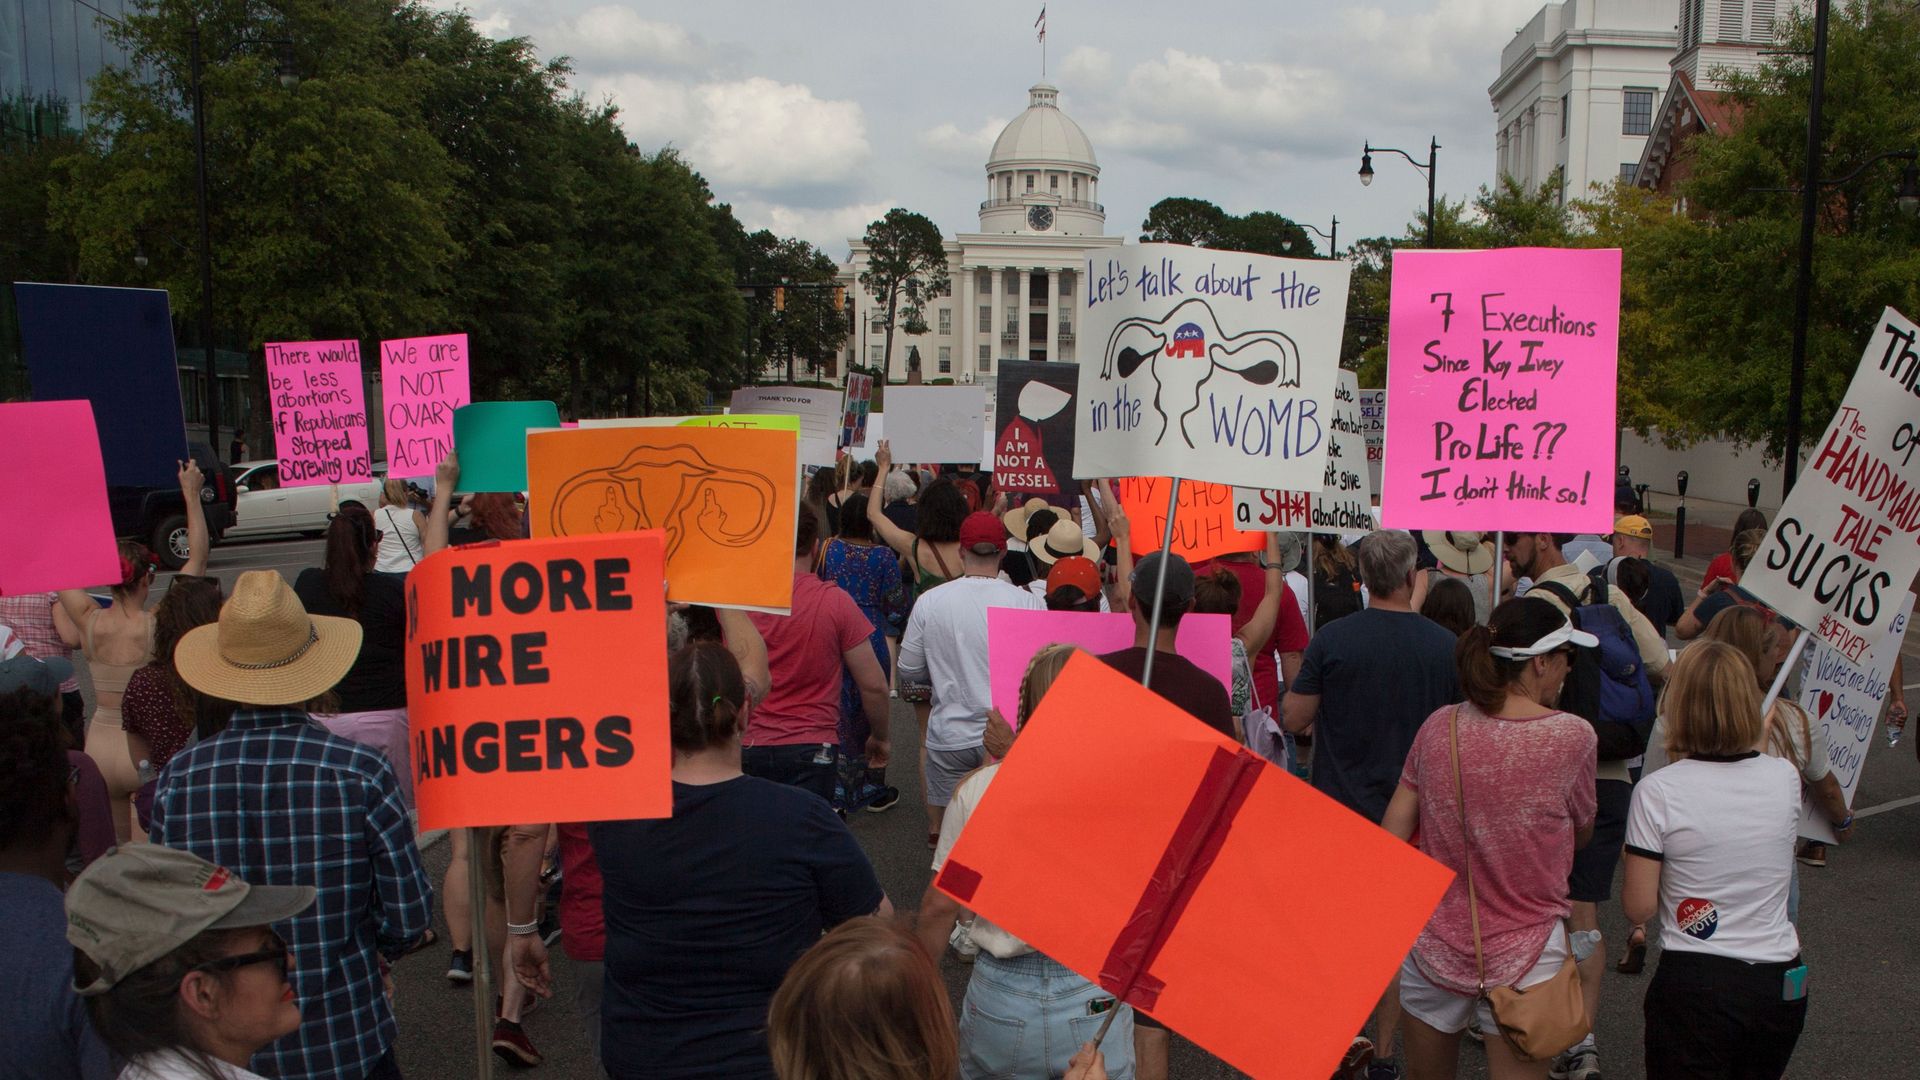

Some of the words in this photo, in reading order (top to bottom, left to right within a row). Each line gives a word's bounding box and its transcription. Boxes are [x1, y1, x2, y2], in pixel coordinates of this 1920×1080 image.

[1088, 258, 1129, 308] Let's
[1135, 257, 1183, 302] talk
[1195, 263, 1261, 301] about
[1272, 270, 1321, 309] the
[1430, 292, 1455, 333] 7
[1482, 292, 1597, 338] Executions
[266, 345, 311, 366] There
[317, 342, 359, 363] would
[384, 340, 417, 365] We
[429, 344, 460, 362] are
[1423, 340, 1470, 373] Since
[1483, 339, 1511, 380] Kay
[1518, 341, 1564, 379] Ivey
[1879, 323, 1920, 398] Thi
[270, 372, 293, 391] be
[304, 370, 339, 388] less
[400, 369, 454, 396] NOT
[1458, 377, 1537, 412] Elected
[277, 389, 352, 408] abortions
[390, 398, 460, 430] OVARY
[1090, 400, 1108, 432] in
[1113, 383, 1142, 432] the
[275, 411, 288, 435] if
[294, 410, 367, 434] Republicans
[1014, 427, 1020, 440] I
[1209, 393, 1322, 459] WOMB
[1842, 406, 1867, 440] The
[996, 454, 1031, 467] NOT
[1034, 456, 1045, 469] A
[1005, 441, 1029, 453] AM
[346, 451, 372, 478] us!
[996, 472, 1056, 488] VESSEL.
[1340, 469, 1361, 491] give
[1126, 477, 1156, 503] MY
[1420, 467, 1451, 501] I
[1454, 474, 1498, 504] don't
[1506, 470, 1552, 501] think
[1555, 470, 1591, 506] so!
[1813, 428, 1920, 545] HANDMAID
[1237, 502, 1251, 523] a
[1312, 498, 1340, 528] about
[1340, 501, 1374, 532] children
[1833, 504, 1893, 562] TALE
[451, 557, 633, 617] MORE
[1766, 517, 1891, 626] SUCKS
[421, 631, 550, 694] WIRE
[1816, 648, 1850, 687] Violets
[1848, 672, 1865, 692] are
[1863, 667, 1886, 701] blue
[1808, 688, 1821, 715] I
[1683, 904, 1696, 915] I'M
[1689, 912, 1717, 934] VOTE
